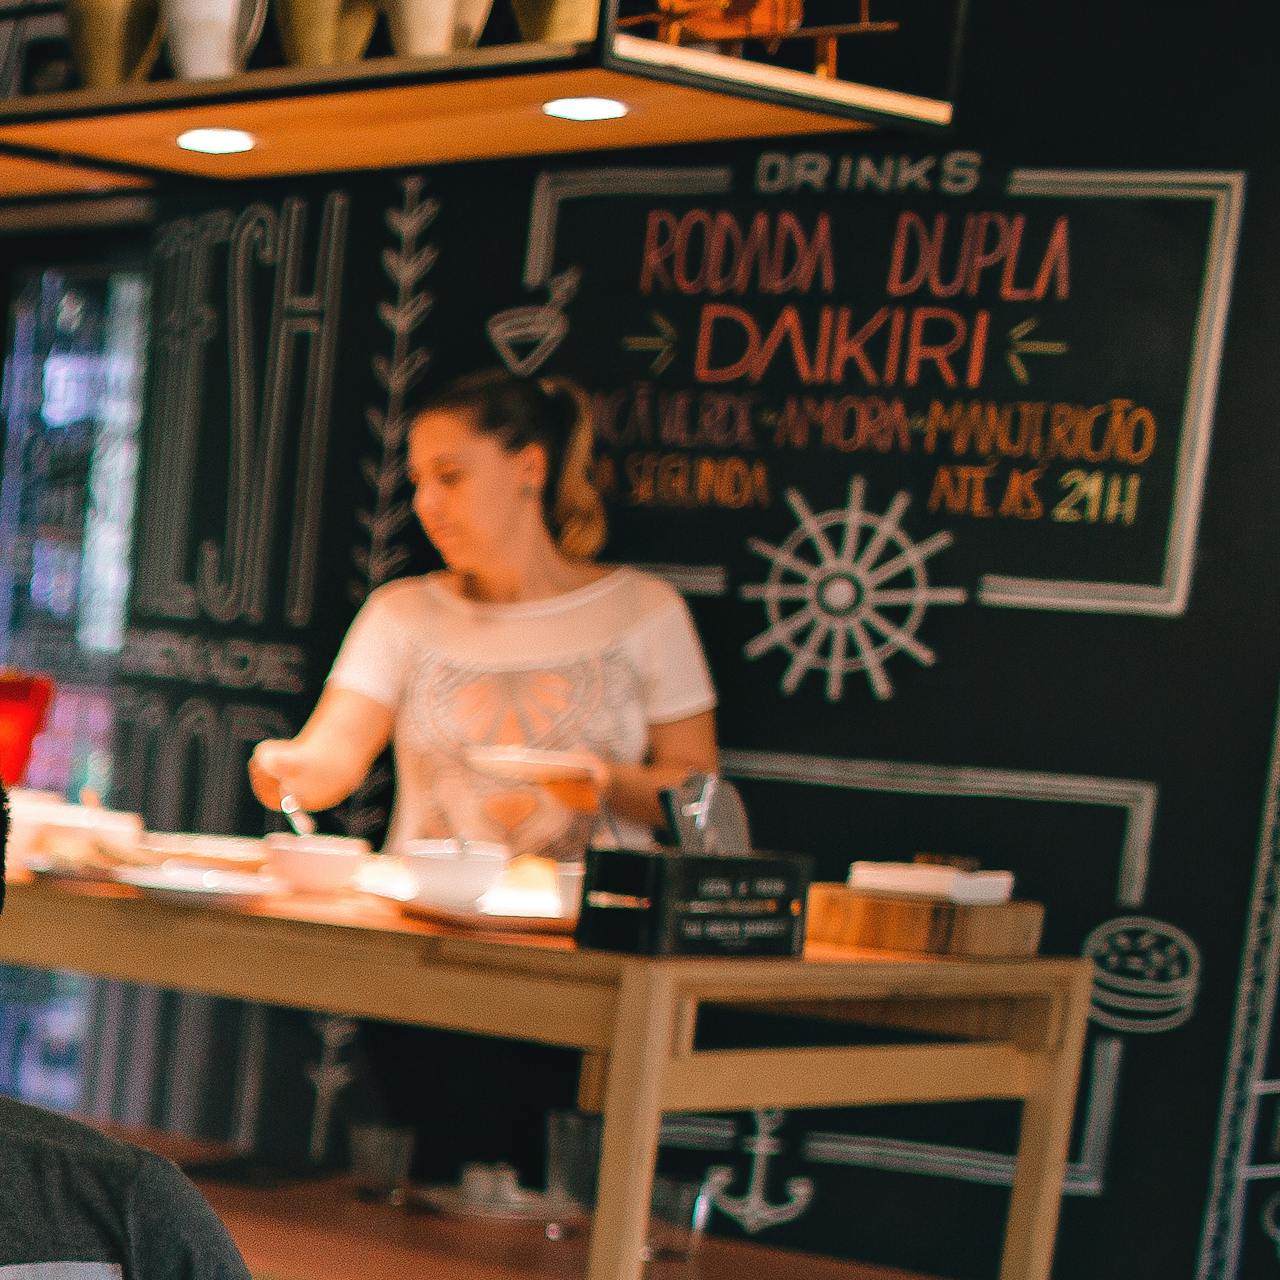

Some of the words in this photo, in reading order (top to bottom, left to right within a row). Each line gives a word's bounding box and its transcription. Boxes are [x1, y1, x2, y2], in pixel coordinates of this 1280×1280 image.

[753, 151, 983, 195] DRINKS
[640, 208, 835, 296] RODADA
[886, 210, 1071, 300] DUPLA
[693, 303, 990, 389] DAIKIRI
[774, 393, 912, 453] AMORA
[1051, 468, 1142, 527] 21H
